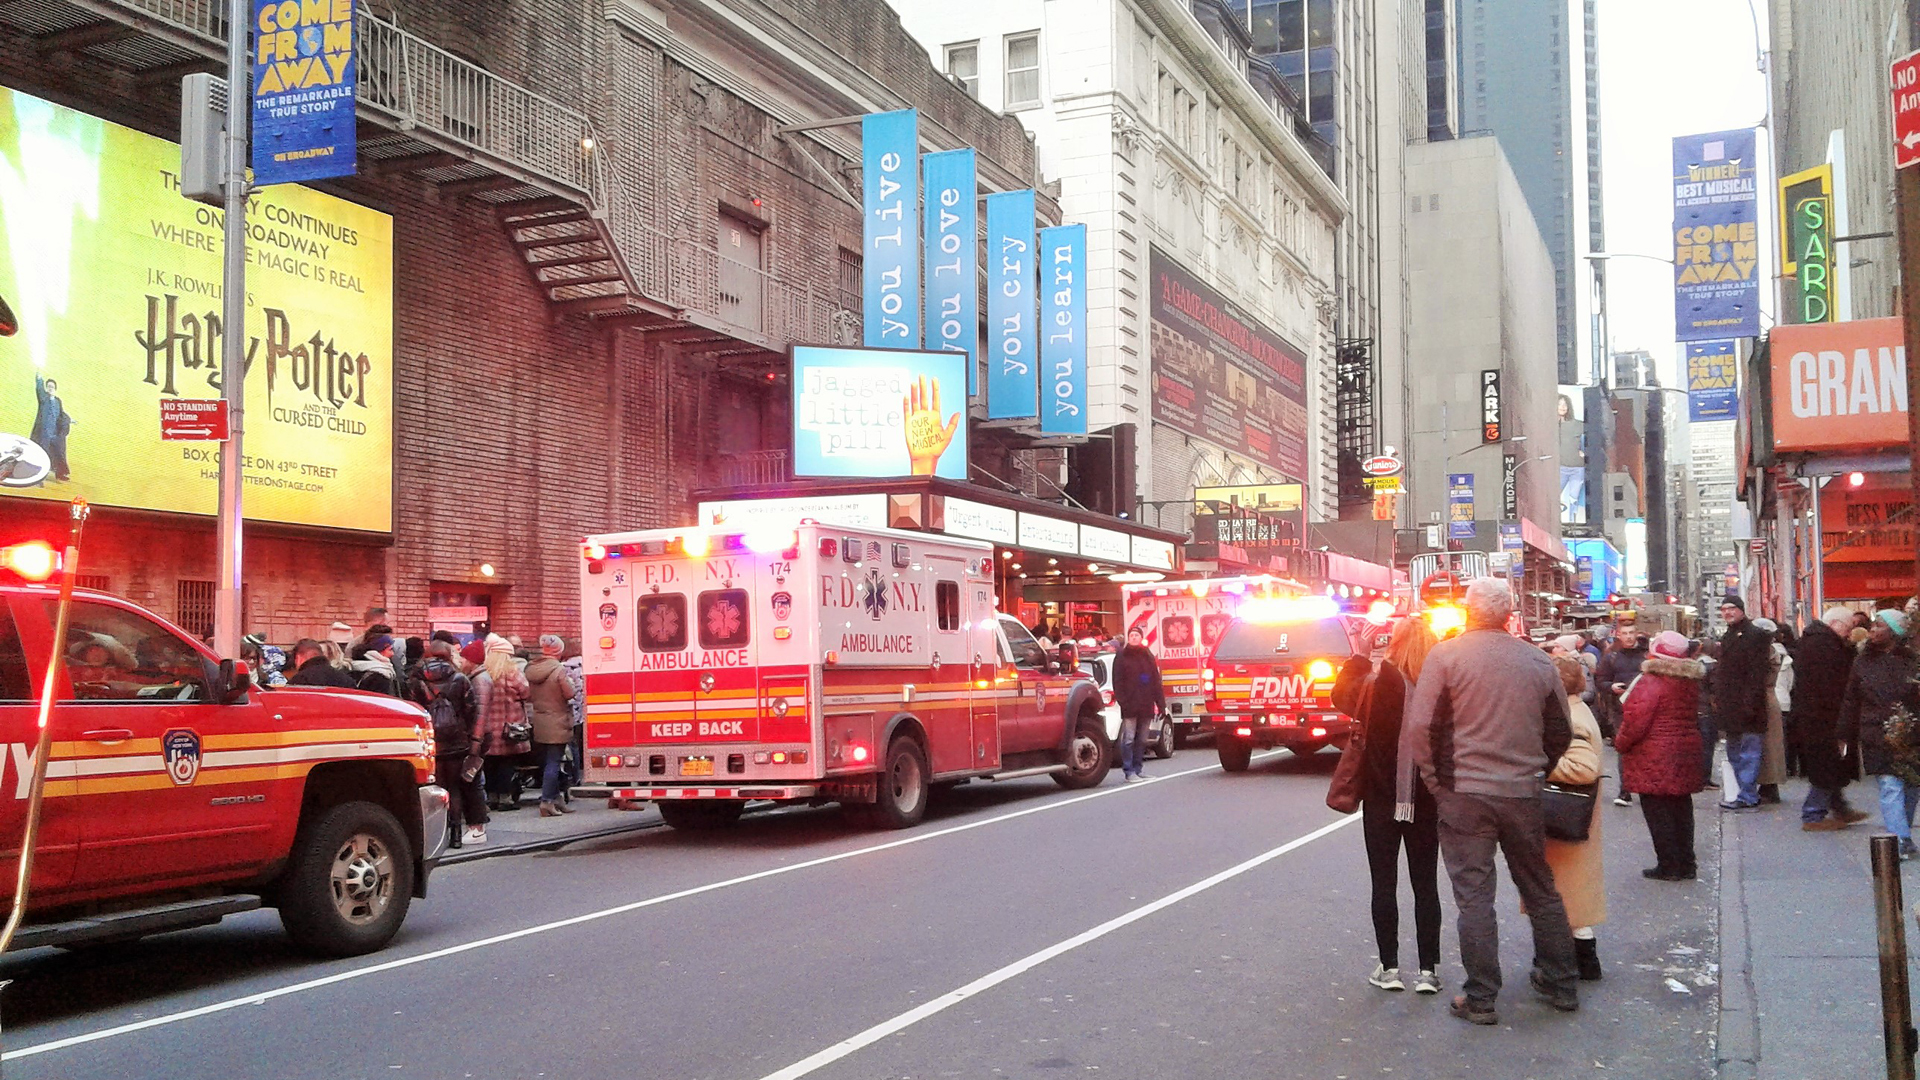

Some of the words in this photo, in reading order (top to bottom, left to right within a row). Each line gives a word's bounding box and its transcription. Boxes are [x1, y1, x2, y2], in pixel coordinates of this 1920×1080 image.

[259, 0, 351, 33] COME
[257, 52, 352, 96] AWAY
[1897, 66, 1917, 90] NO
[256, 96, 276, 110] THE
[279, 86, 352, 106] REMARKABLE
[270, 104, 298, 119] TRUE
[301, 99, 336, 115] STORY
[875, 151, 902, 249] live
[1676, 182, 1703, 199] BEST
[1705, 178, 1755, 196] MUSICAL
[151, 219, 216, 253] WHERE
[264, 203, 359, 247] CONTINUES
[935, 187, 961, 277] love
[1676, 222, 1755, 245] COME
[258, 249, 309, 278] MAGIC
[314, 265, 325, 281] IS
[329, 270, 365, 294] REAL
[1002, 235, 1026, 298] cry
[1677, 259, 1756, 285] AWAY
[1803, 201, 1827, 323] SARD
[147, 267, 170, 287] J.K.
[1697, 281, 1757, 292] REMARKABLE
[881, 264, 909, 339] you
[1050, 244, 1073, 345] learn
[1715, 289, 1745, 298] STORY
[1003, 312, 1028, 375] you
[263, 307, 372, 421] Potter
[1688, 354, 1735, 367] COME
[811, 369, 903, 398] jagged
[1055, 357, 1079, 417] you
[1690, 376, 1736, 390] AWAY
[163, 402, 176, 411] NO
[177, 403, 218, 412] STANDING
[303, 402, 320, 412] AND
[322, 405, 337, 416] THE
[1484, 372, 1499, 423] PARK
[164, 412, 199, 423] Anytime
[273, 407, 324, 430] CURSED
[327, 415, 367, 436] CHILD
[808, 400, 900, 427] little
[911, 416, 929, 428] OUR
[827, 430, 887, 454] pill
[912, 425, 933, 440] NEW
[912, 433, 944, 450] MUSICAL
[183, 447, 210, 462] BOX
[256, 458, 274, 470] ON
[300, 464, 338, 479] STREET
[645, 563, 680, 584] F.D.
[706, 559, 741, 581] N.Y.
[768, 562, 792, 576] 174
[820, 575, 860, 609] F.D.
[892, 581, 926, 612] N.Y.
[977, 590, 987, 603] 174
[1165, 600, 1188, 612] F.D.
[1205, 598, 1228, 610] N.Y.
[840, 633, 913, 654] AMBULANCE
[640, 649, 749, 671] AMBULANCE
[1173, 685, 1199, 694] KEEP
[1250, 673, 1316, 699] FDNY
[651, 723, 693, 738] KEEP
[699, 721, 743, 736] BACK
